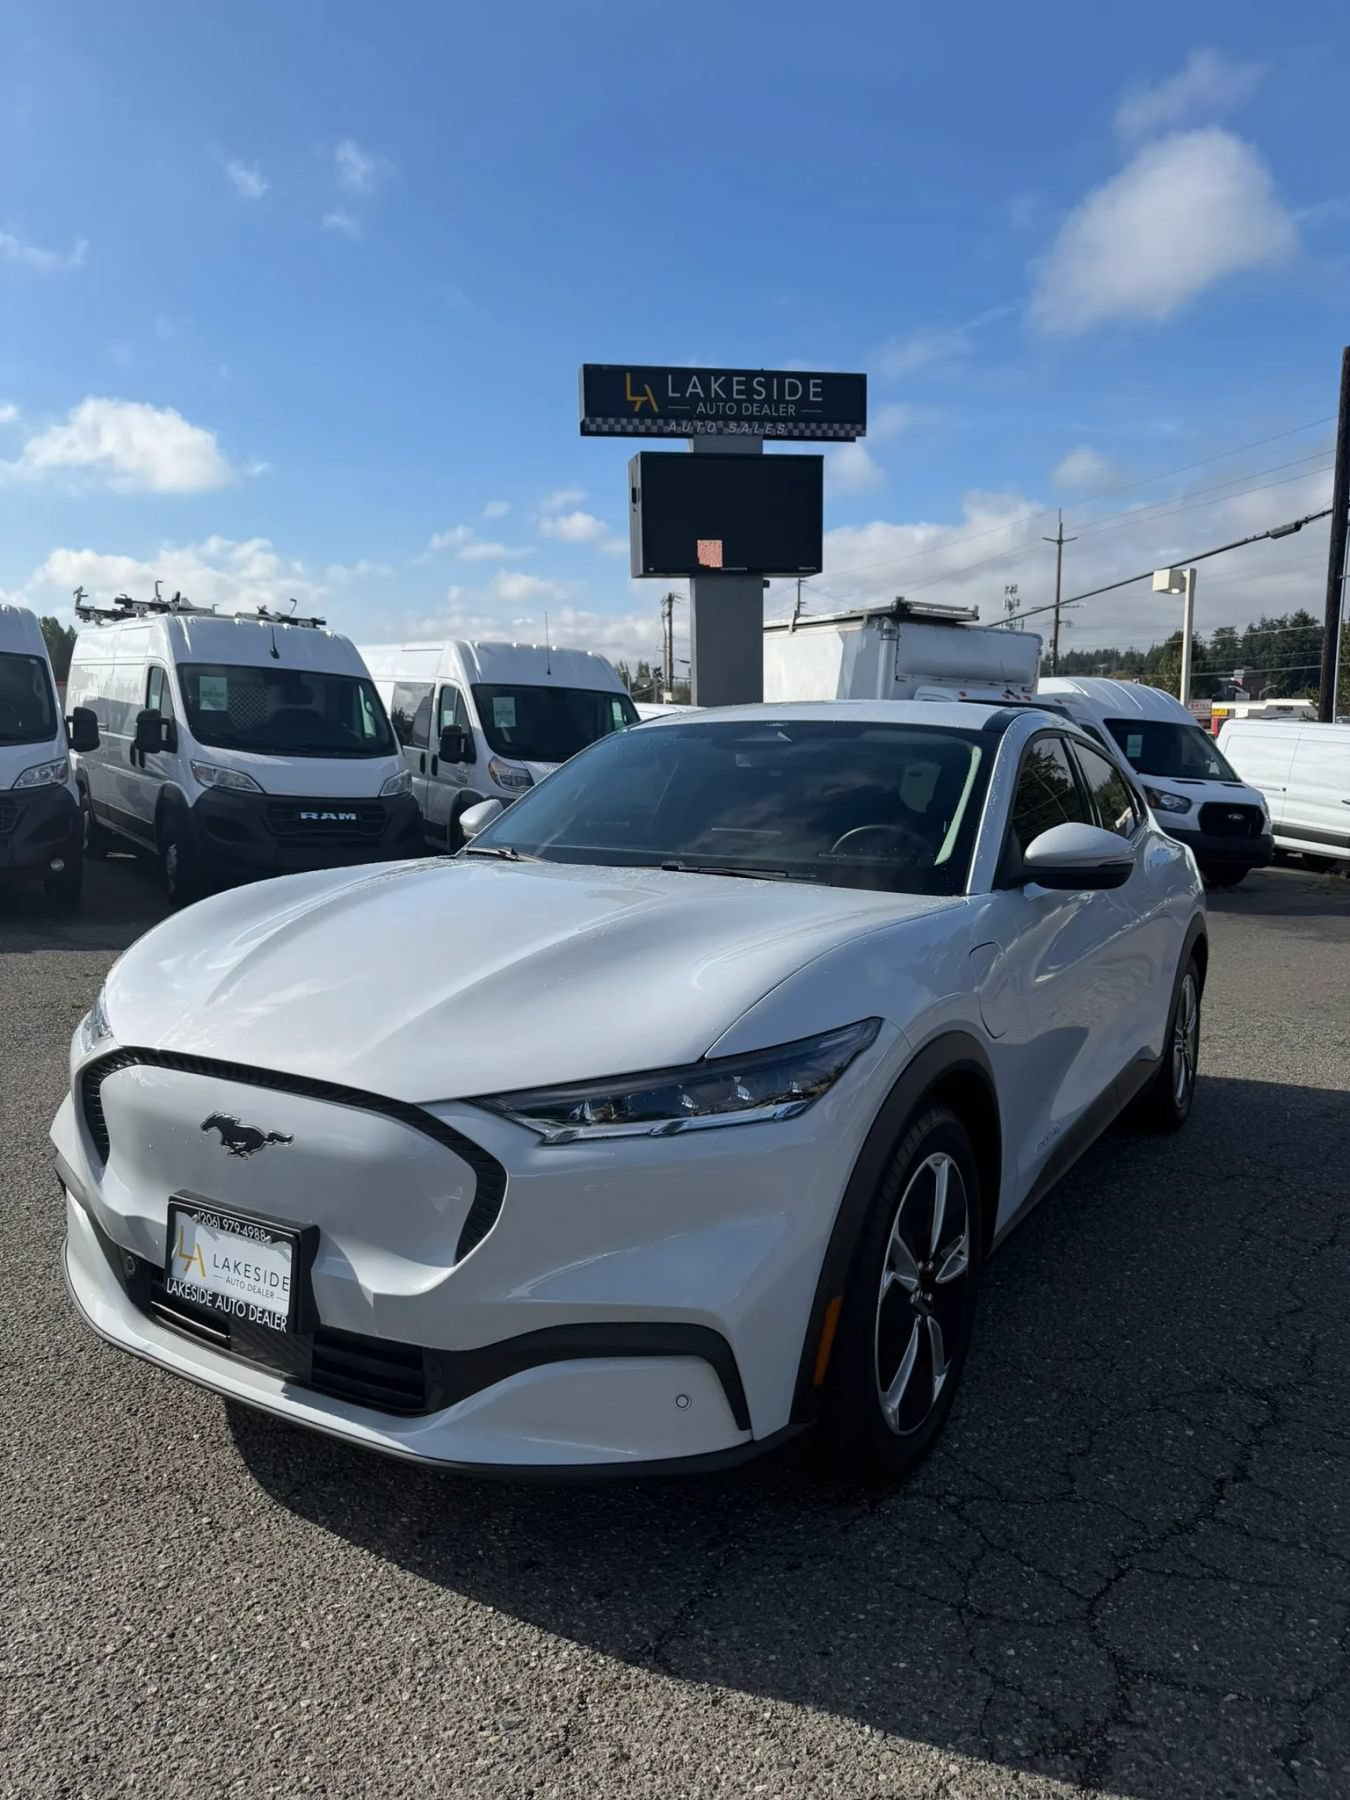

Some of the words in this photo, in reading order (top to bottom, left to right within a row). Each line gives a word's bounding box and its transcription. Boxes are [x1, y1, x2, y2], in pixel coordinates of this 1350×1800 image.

[667, 374, 823, 401] LAKESIDE
[696, 402, 737, 415] AUTO
[742, 403, 796, 416] DEALER
[667, 421, 717, 433] AUTO
[728, 423, 787, 434] SALES
[300, 812, 357, 820] RAM
[199, 1211, 221, 1229] (206)
[222, 1218, 266, 1242] 979-4988
[213, 1253, 291, 1292] LAKESIDE
[225, 1276, 246, 1290] AUTO
[247, 1283, 275, 1299] DEALER
[166, 1277, 213, 1307] LAKESIDE
[214, 1294, 247, 1318] AUTO
[248, 1305, 288, 1333] DEALER
